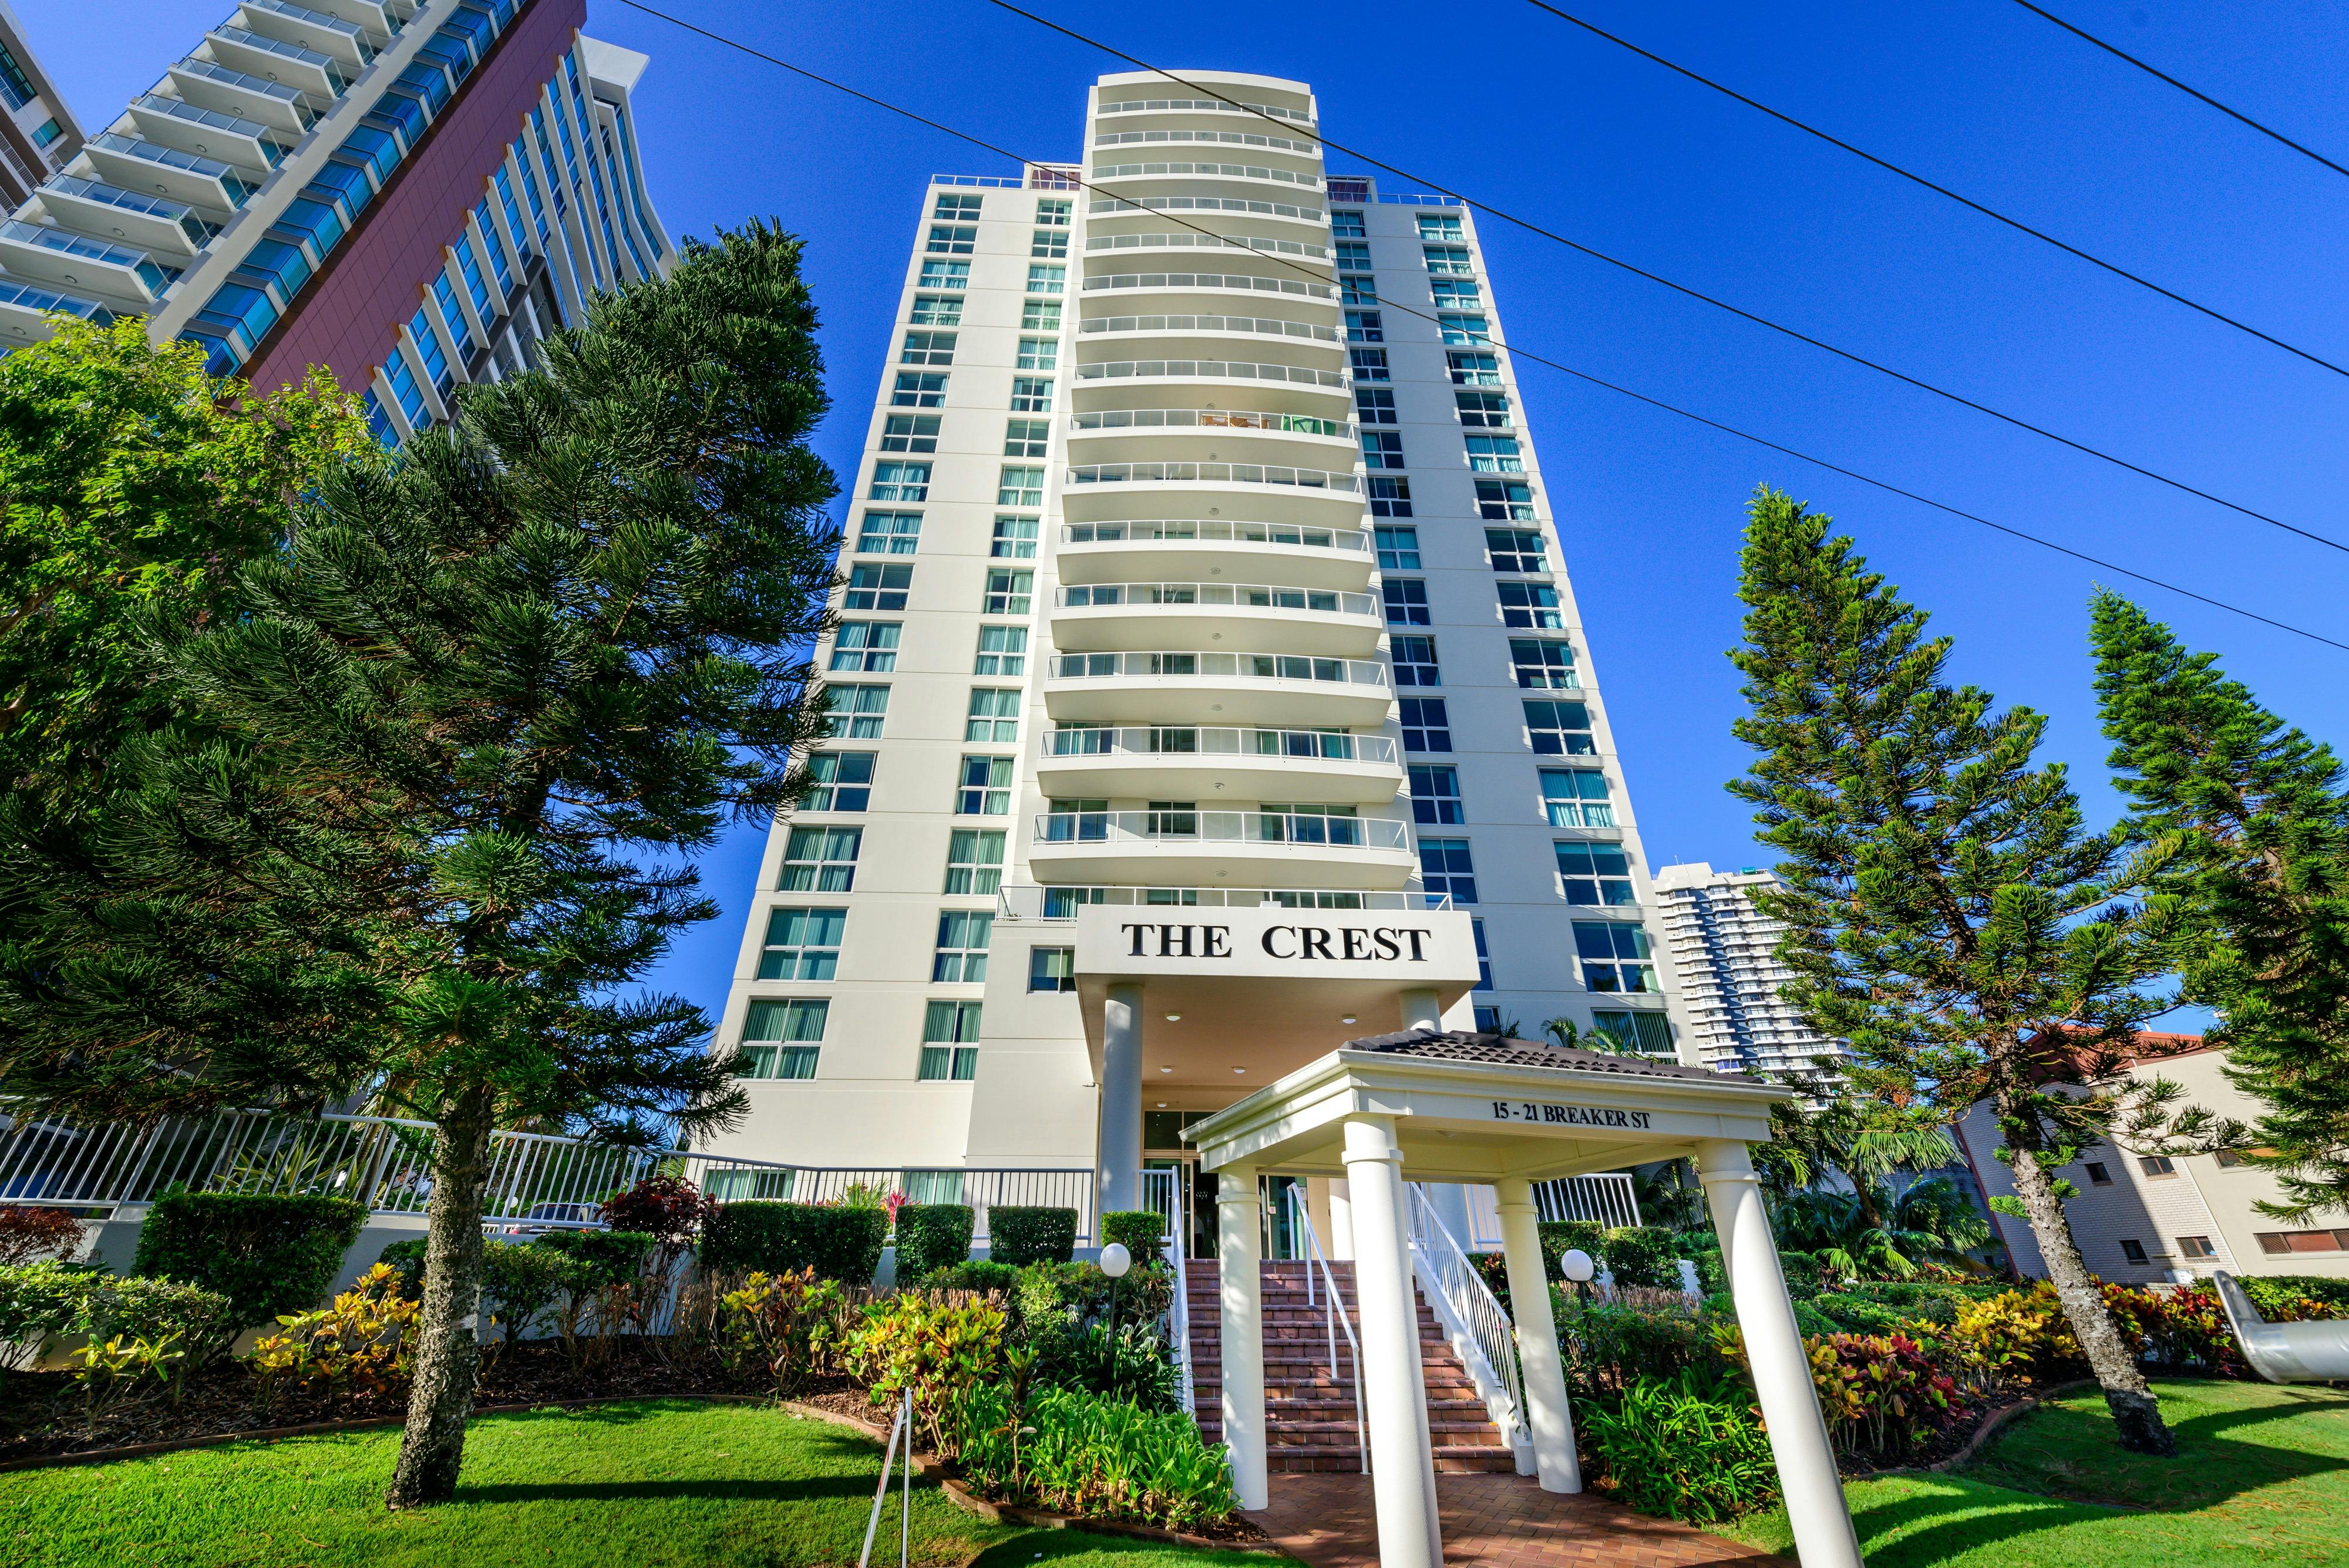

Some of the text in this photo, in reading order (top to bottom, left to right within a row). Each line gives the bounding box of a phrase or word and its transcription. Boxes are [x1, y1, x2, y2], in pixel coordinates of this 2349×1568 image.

[1121, 924, 1432, 961] THE CREST
[1492, 1101, 1509, 1119] 15
[1522, 1103, 1540, 1121] 21
[1542, 1105, 1630, 1128] BREAKER
[1630, 1111, 1651, 1129] ST
